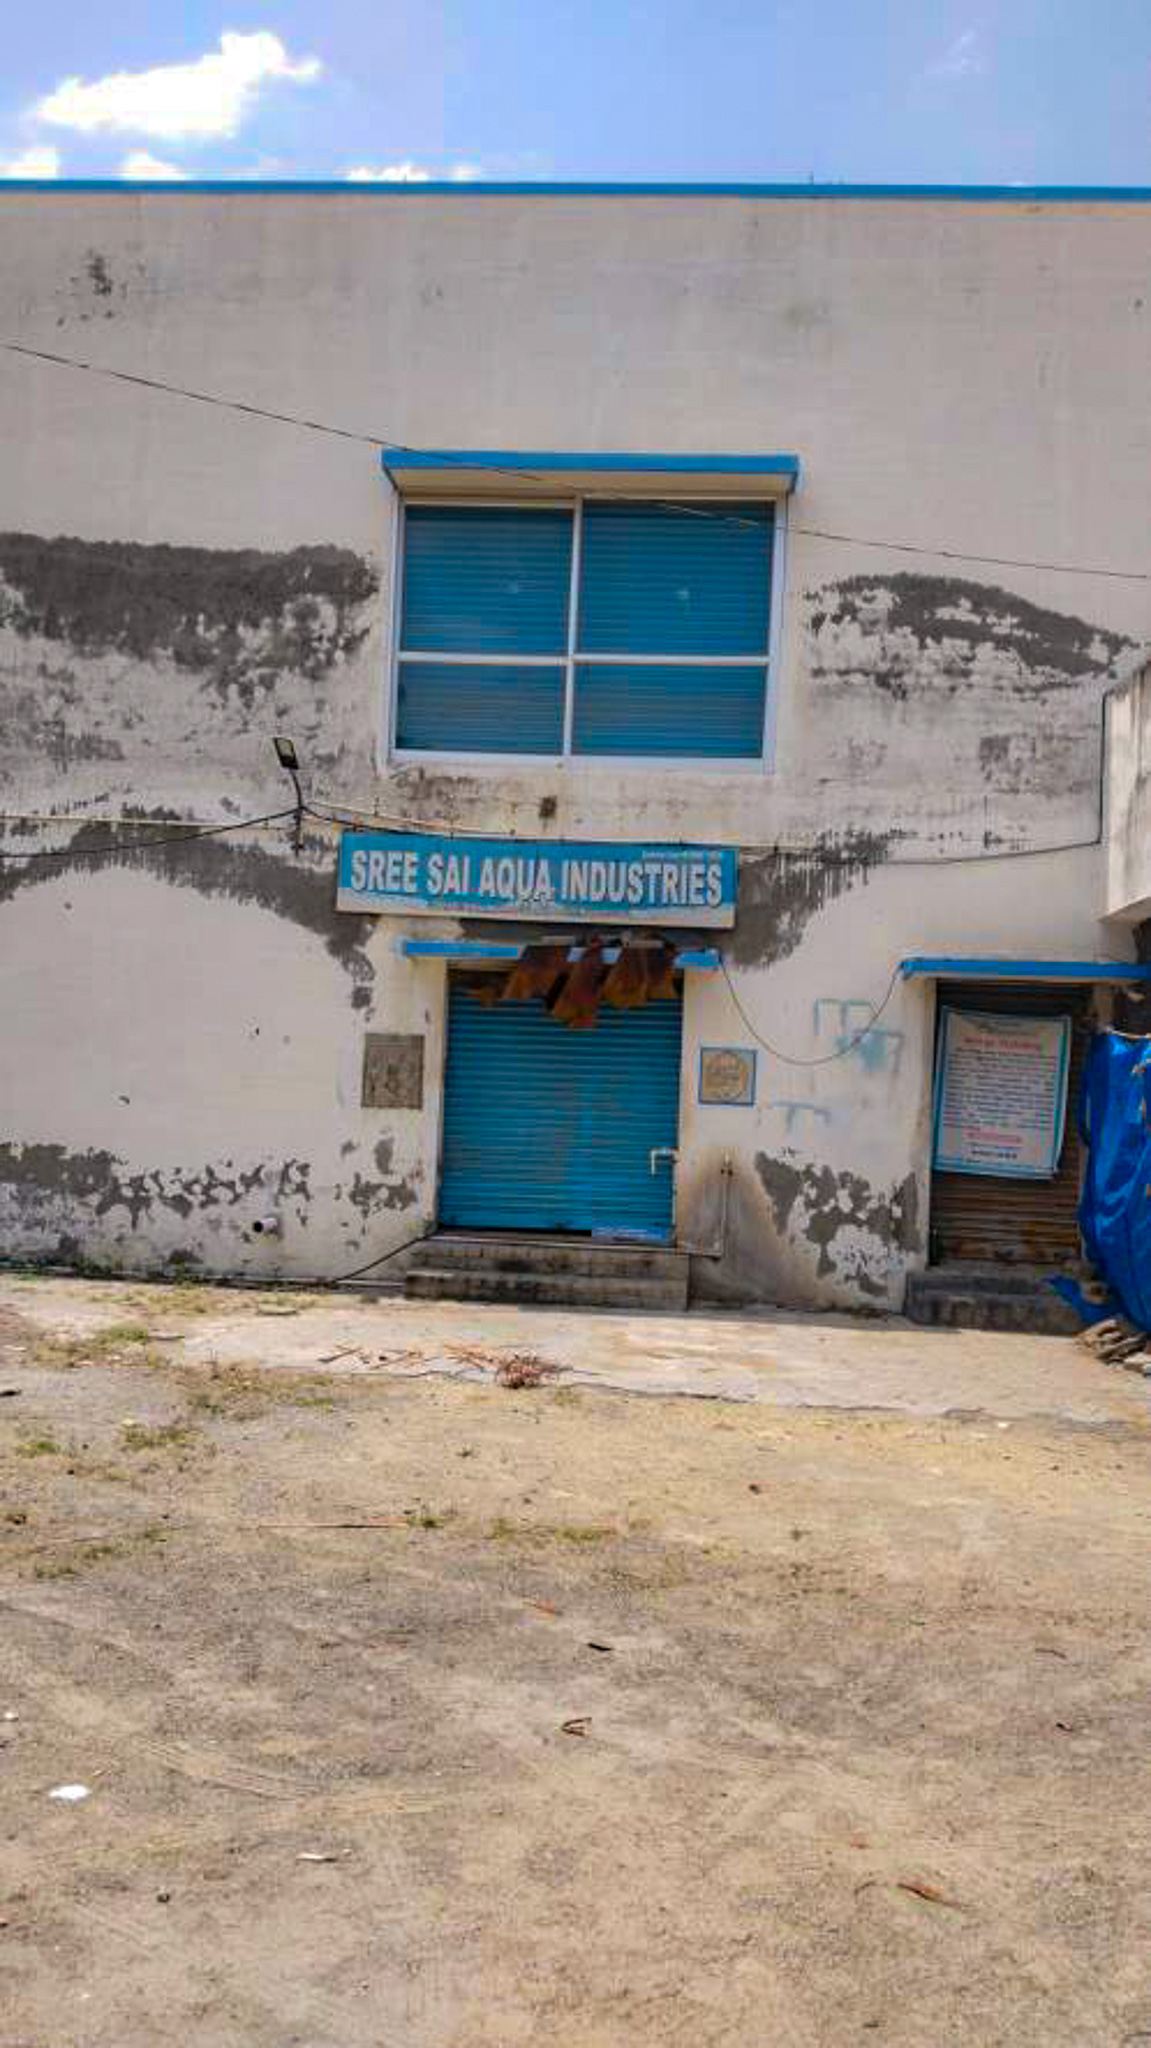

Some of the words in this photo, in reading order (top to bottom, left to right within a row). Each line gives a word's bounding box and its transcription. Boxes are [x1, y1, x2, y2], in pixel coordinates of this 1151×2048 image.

[351, 850, 418, 892] SREE
[427, 853, 471, 895] SAI
[480, 857, 552, 899] AQUA
[561, 860, 722, 907] INDUSTRIES
